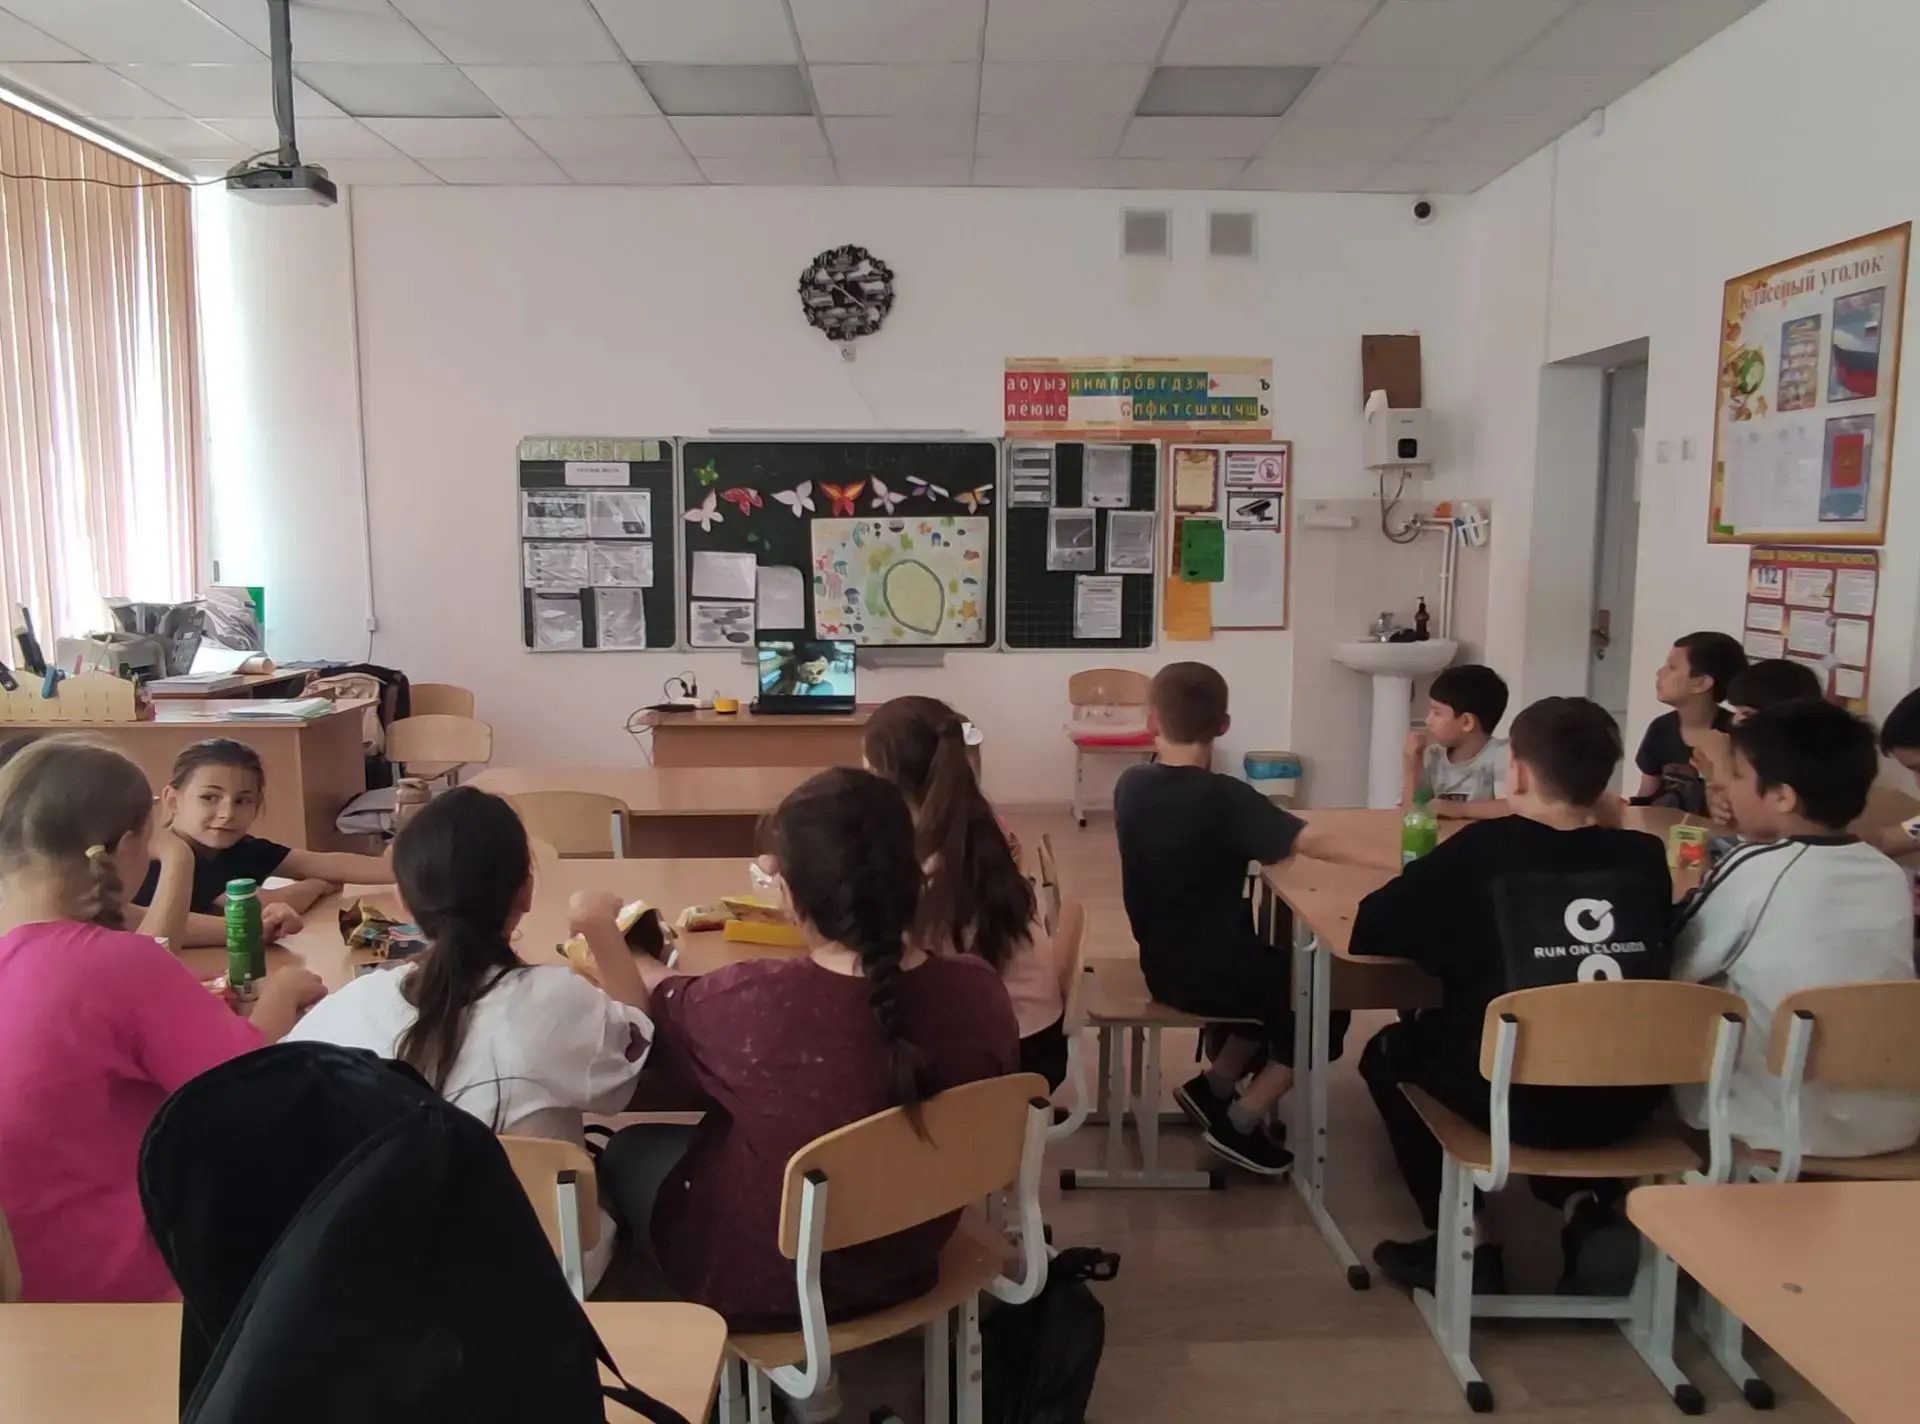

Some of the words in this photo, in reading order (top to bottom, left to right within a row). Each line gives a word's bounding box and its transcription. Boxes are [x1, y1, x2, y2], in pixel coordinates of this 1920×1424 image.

[1819, 255, 1885, 295] уголок
[1757, 567, 1778, 585] 112
[1534, 947, 1567, 959] RUN
[1569, 944, 1590, 955] ON
